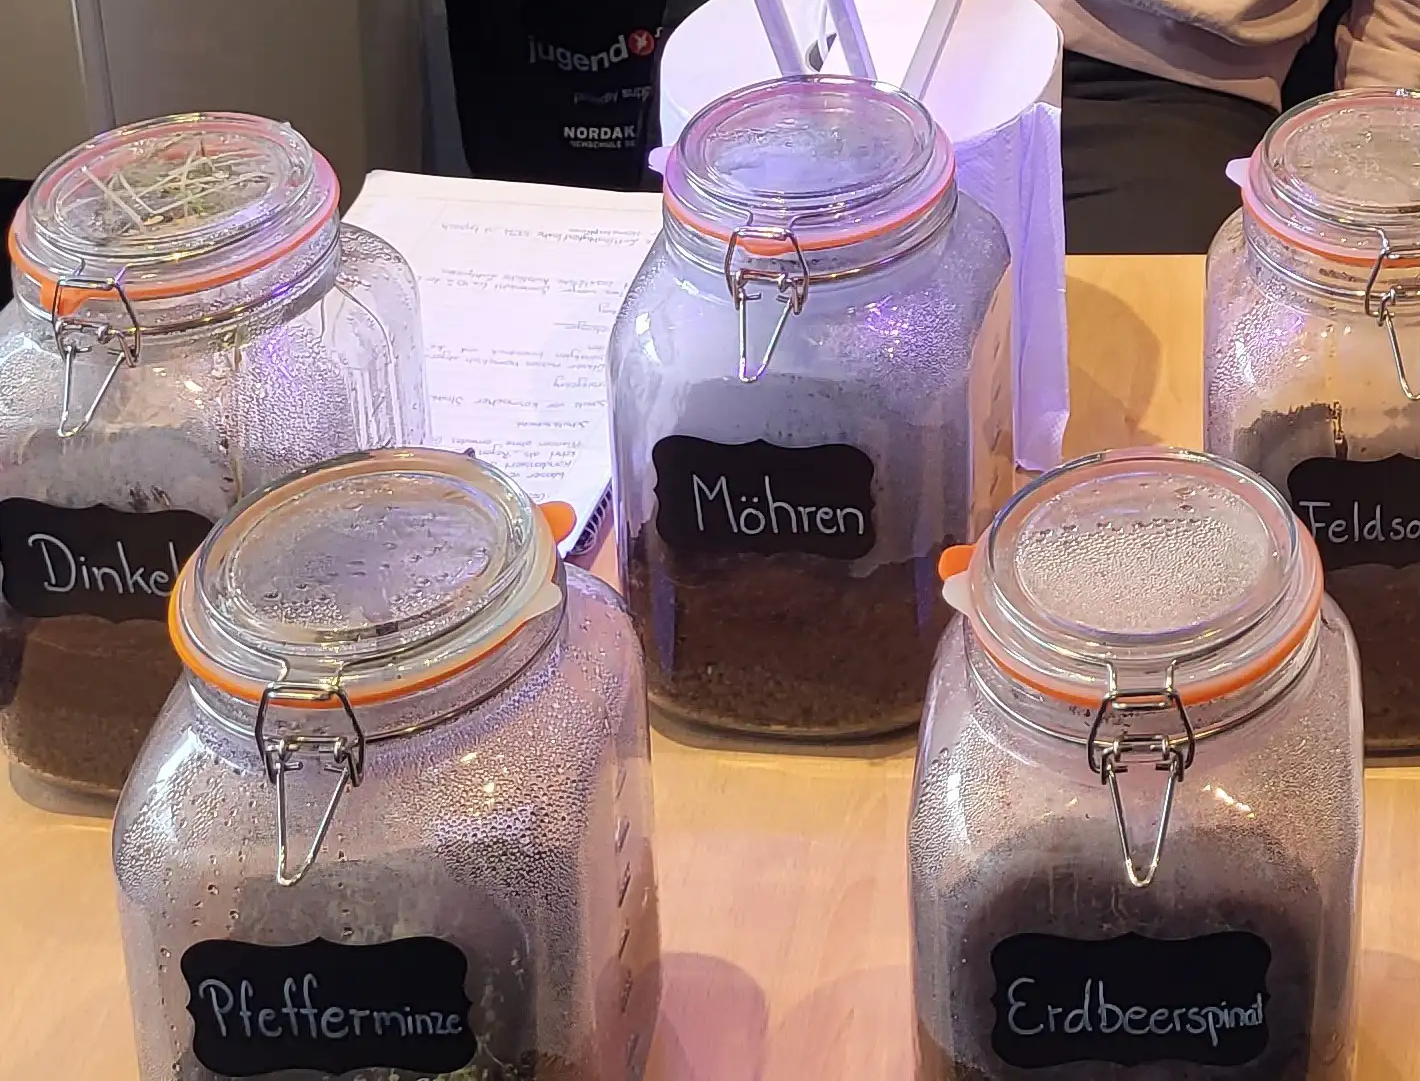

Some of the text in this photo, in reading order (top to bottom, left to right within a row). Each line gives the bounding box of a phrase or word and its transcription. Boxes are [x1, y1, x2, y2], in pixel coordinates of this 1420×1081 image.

[527, 34, 629, 72] jugend
[692, 473, 865, 536] Möhren
[27, 532, 180, 598] Dinkel
[198, 972, 464, 1040] Pfefferminze
[1007, 976, 1264, 1048] Erdbeerspinat
